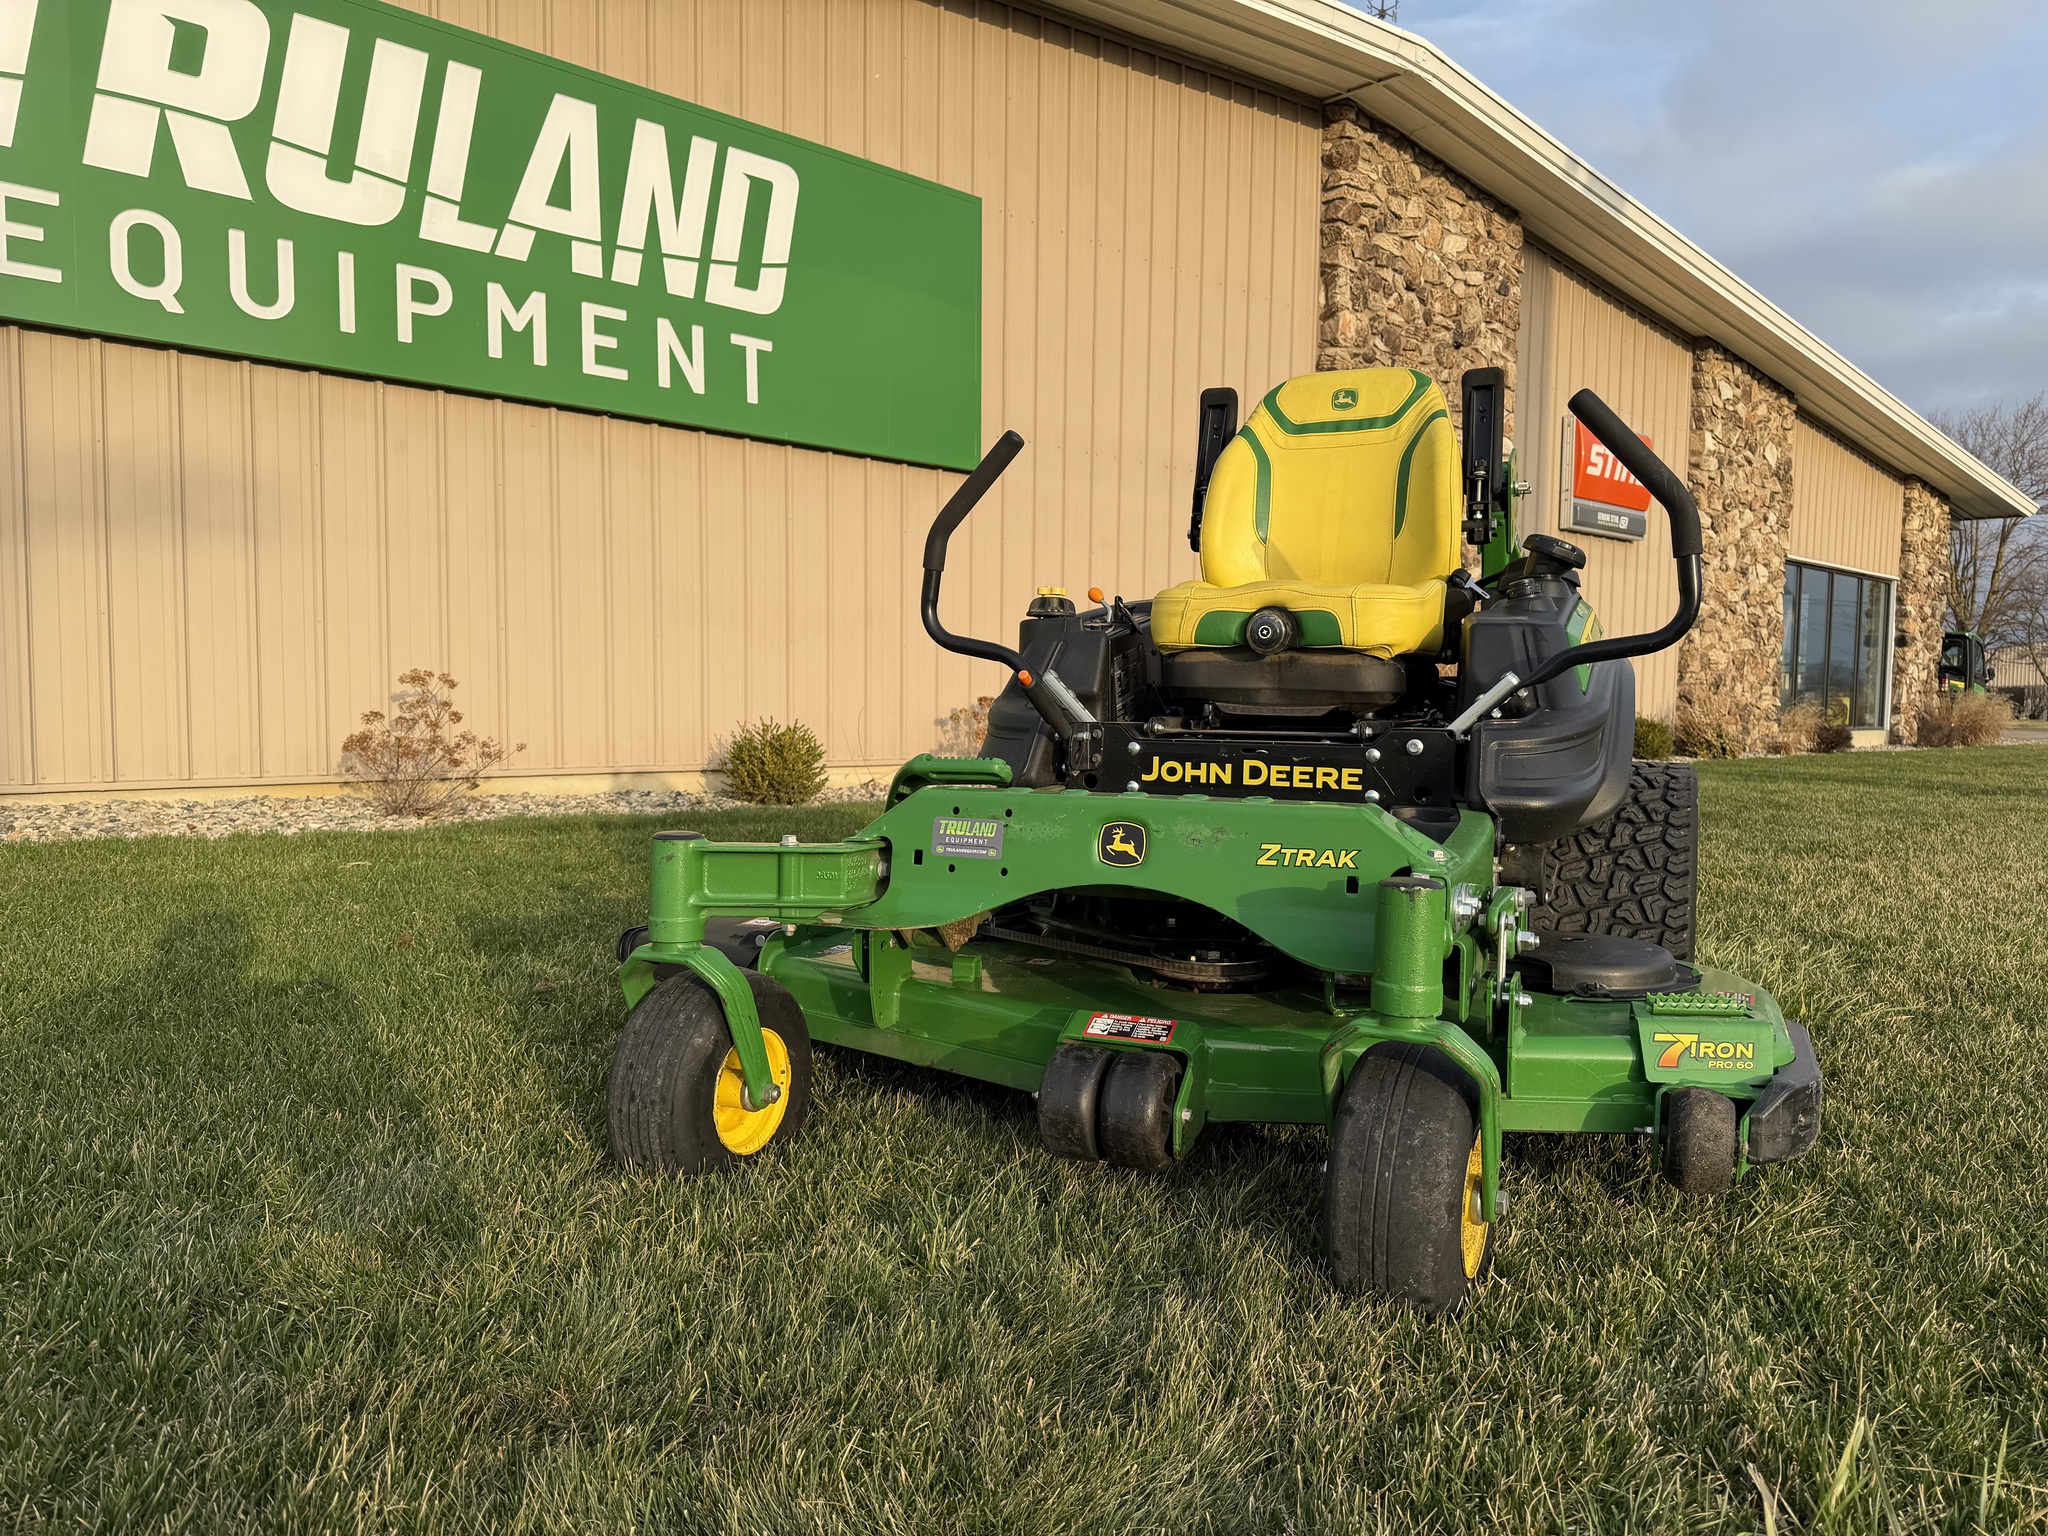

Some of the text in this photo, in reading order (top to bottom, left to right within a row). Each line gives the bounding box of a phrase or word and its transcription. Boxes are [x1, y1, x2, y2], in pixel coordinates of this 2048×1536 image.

[0, 180, 774, 405] EQUIPMENT
[1141, 756, 1364, 791] JOHN DEERE
[939, 820, 998, 837] TRULAND
[945, 837, 989, 845] EQUIPMENT
[1256, 843, 1360, 868] ZTRAK
[1109, 1013, 1132, 1021] DANGER
[1708, 1061, 1754, 1070] PRO 60
